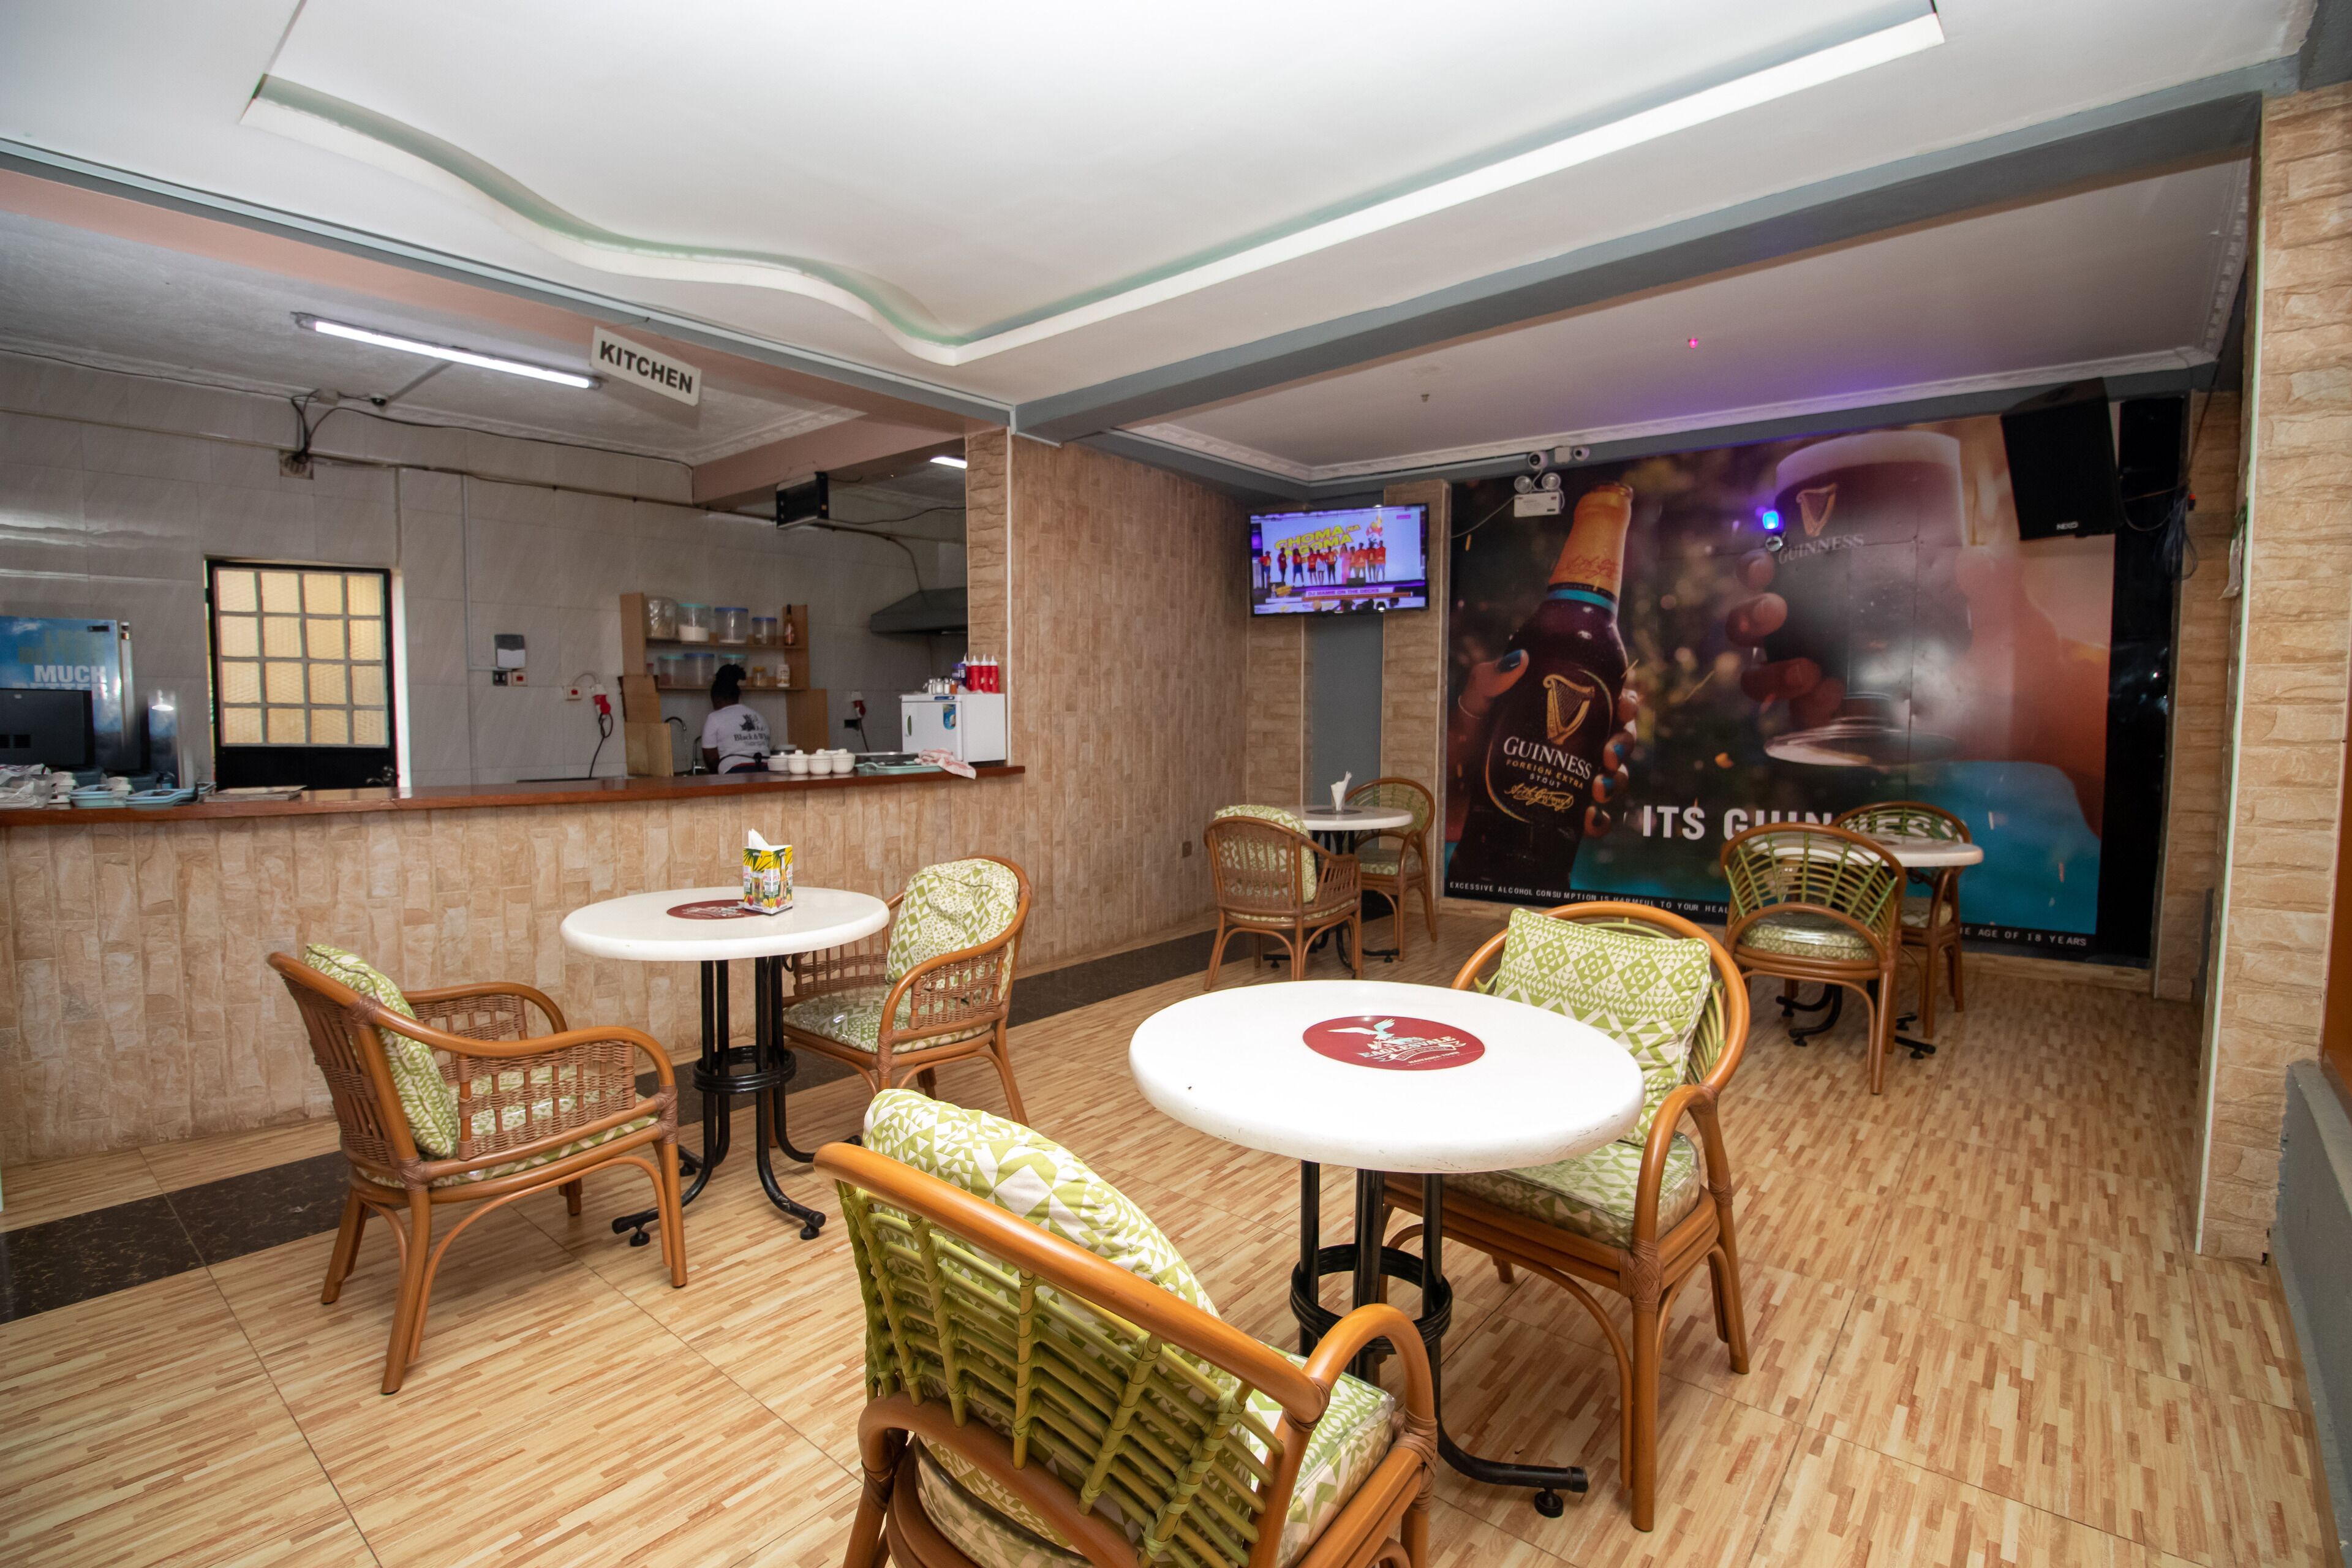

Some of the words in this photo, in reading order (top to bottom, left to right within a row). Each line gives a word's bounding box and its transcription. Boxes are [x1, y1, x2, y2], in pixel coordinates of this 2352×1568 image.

[600, 341, 693, 394] KITCHEN
[1275, 525, 1344, 550] CHOMA
[1779, 534, 1864, 564] GUINNESS
[34, 665, 107, 683] MUCH
[1503, 736, 1592, 780] GUINNESS
[1506, 759, 1552, 776] FOREIGN
[1556, 772, 1583, 790] EXTRA
[1530, 773, 1561, 788] STOUT
[1643, 805, 1705, 840] ITS
[1450, 882, 1493, 892] EXCESSIVE
[1498, 887, 1532, 895] ALCOHOL
[1677, 903, 1698, 911] YOUR
[1705, 905, 1728, 914] HEAL
[1978, 929, 1997, 938] AGE
[2027, 933, 2041, 942] 18
[2049, 935, 2087, 946] YEARS
[1359, 1036, 1456, 1058] EAGLESVALE
